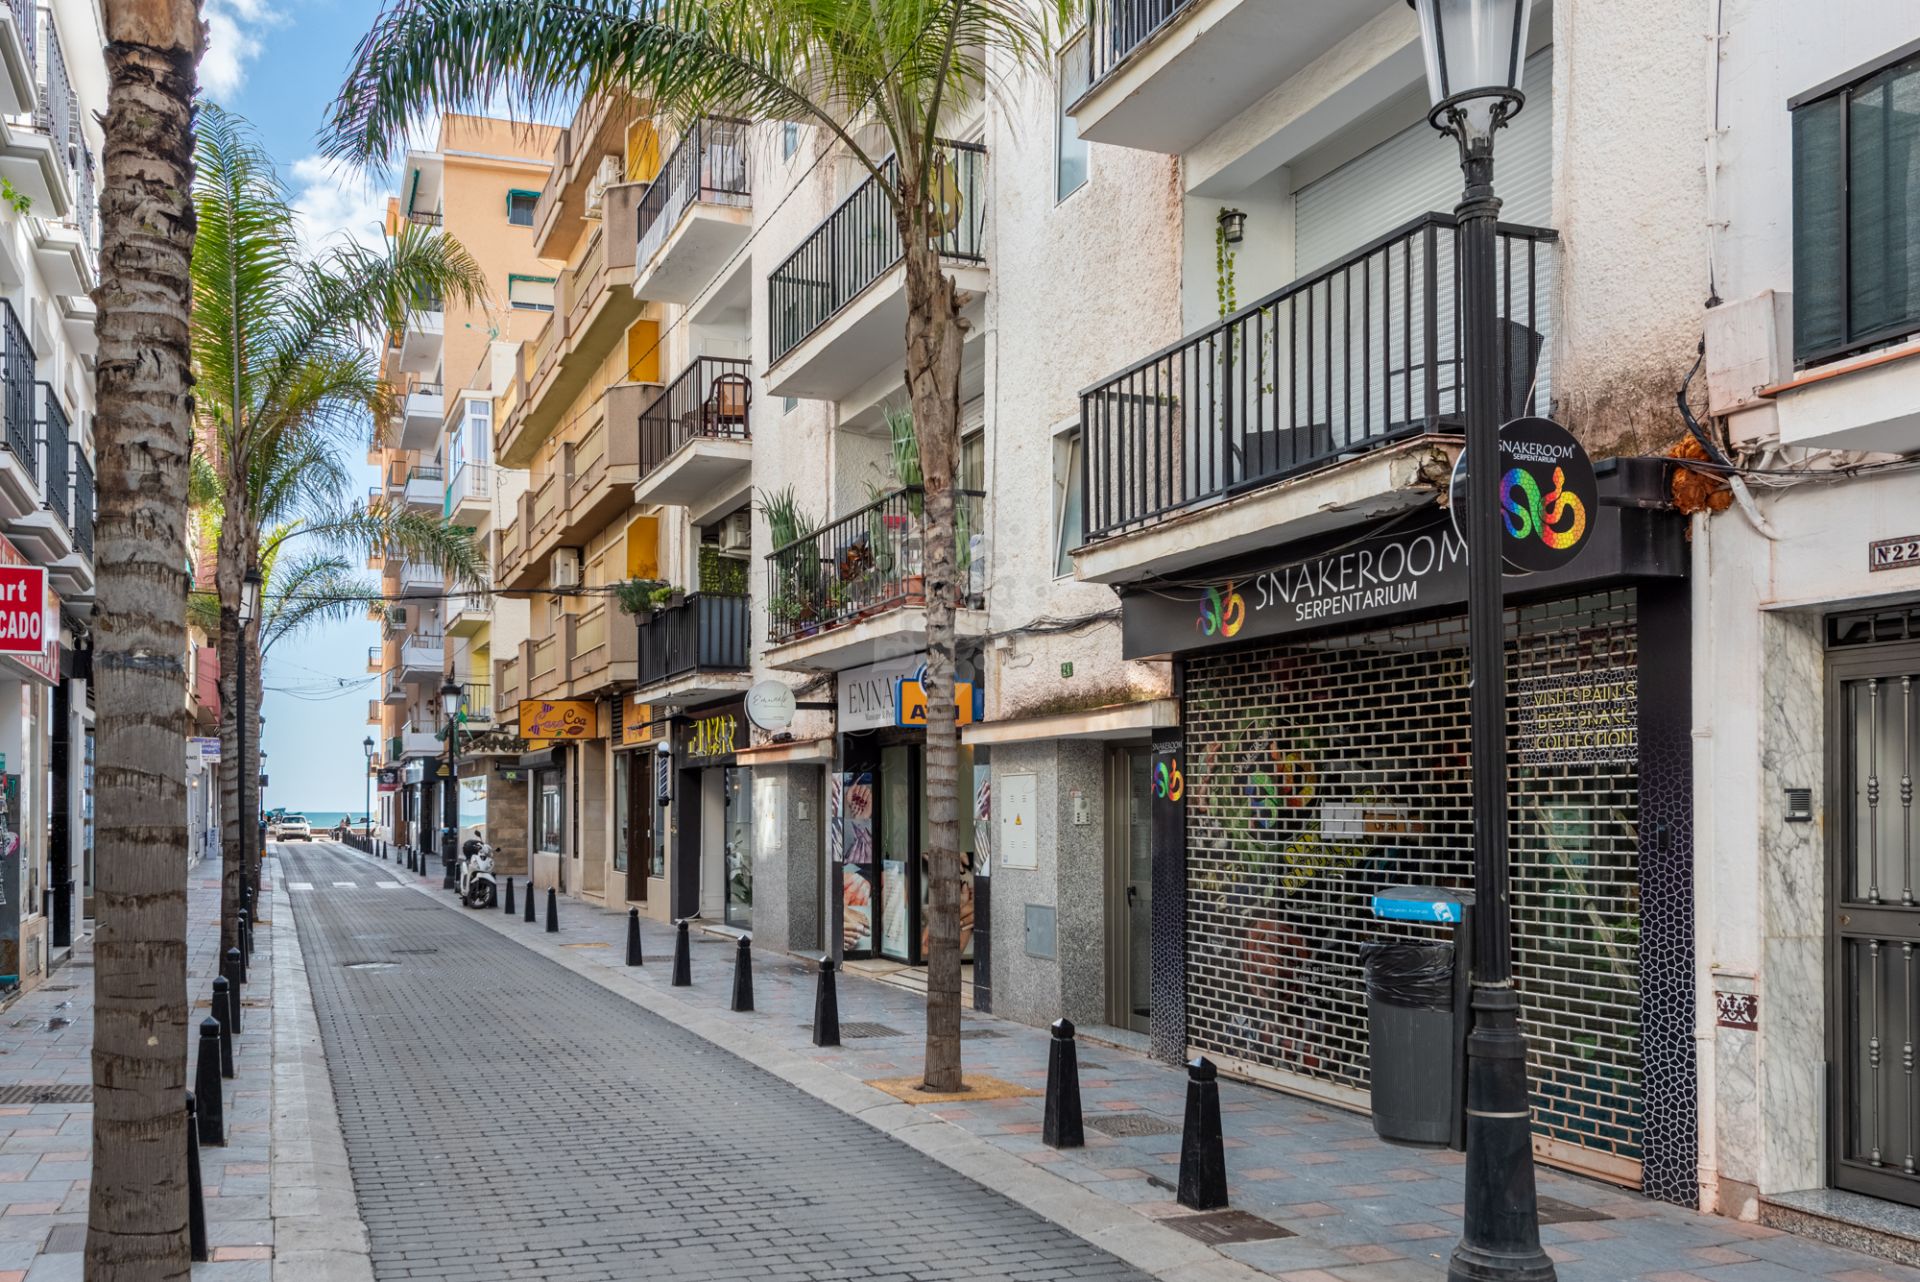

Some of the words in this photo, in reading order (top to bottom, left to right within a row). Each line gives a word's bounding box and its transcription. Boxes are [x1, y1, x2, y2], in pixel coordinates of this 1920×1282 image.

[1513, 452, 1557, 464] SERPENTARIUM
[1256, 530, 1468, 610] SNAKEROOM
[1295, 580, 1417, 622] SERPENTARIUM
[0, 611, 41, 640] CADO
[1534, 690, 1568, 706] VISIT
[1538, 711, 1573, 729] BEST
[1578, 708, 1631, 727] SNAKE
[1536, 730, 1633, 750] COLLECTION
